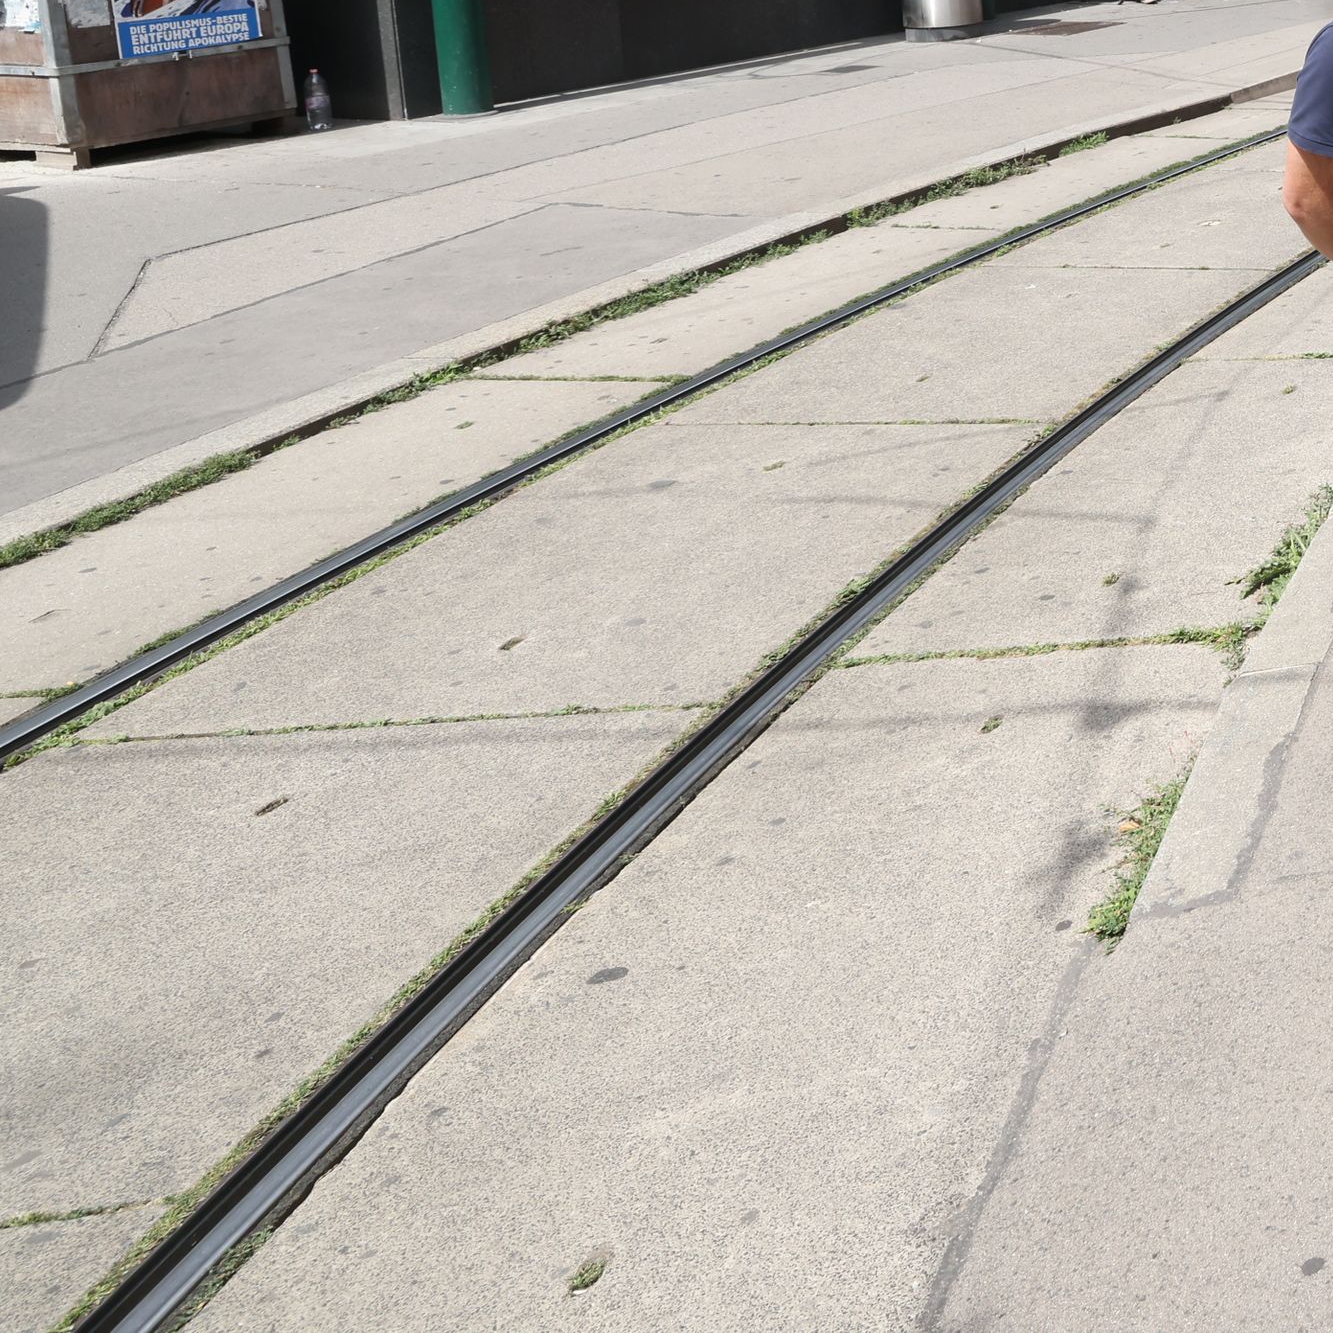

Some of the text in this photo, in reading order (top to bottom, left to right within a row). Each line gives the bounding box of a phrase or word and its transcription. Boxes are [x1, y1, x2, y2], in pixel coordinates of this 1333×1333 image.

[129, 13, 248, 35] DIE POPULISMUS-BESTIE
[130, 22, 250, 46] ENTFÜHRT EUROPA
[132, 32, 250, 55] RICHTUNG APOKALYPSE
